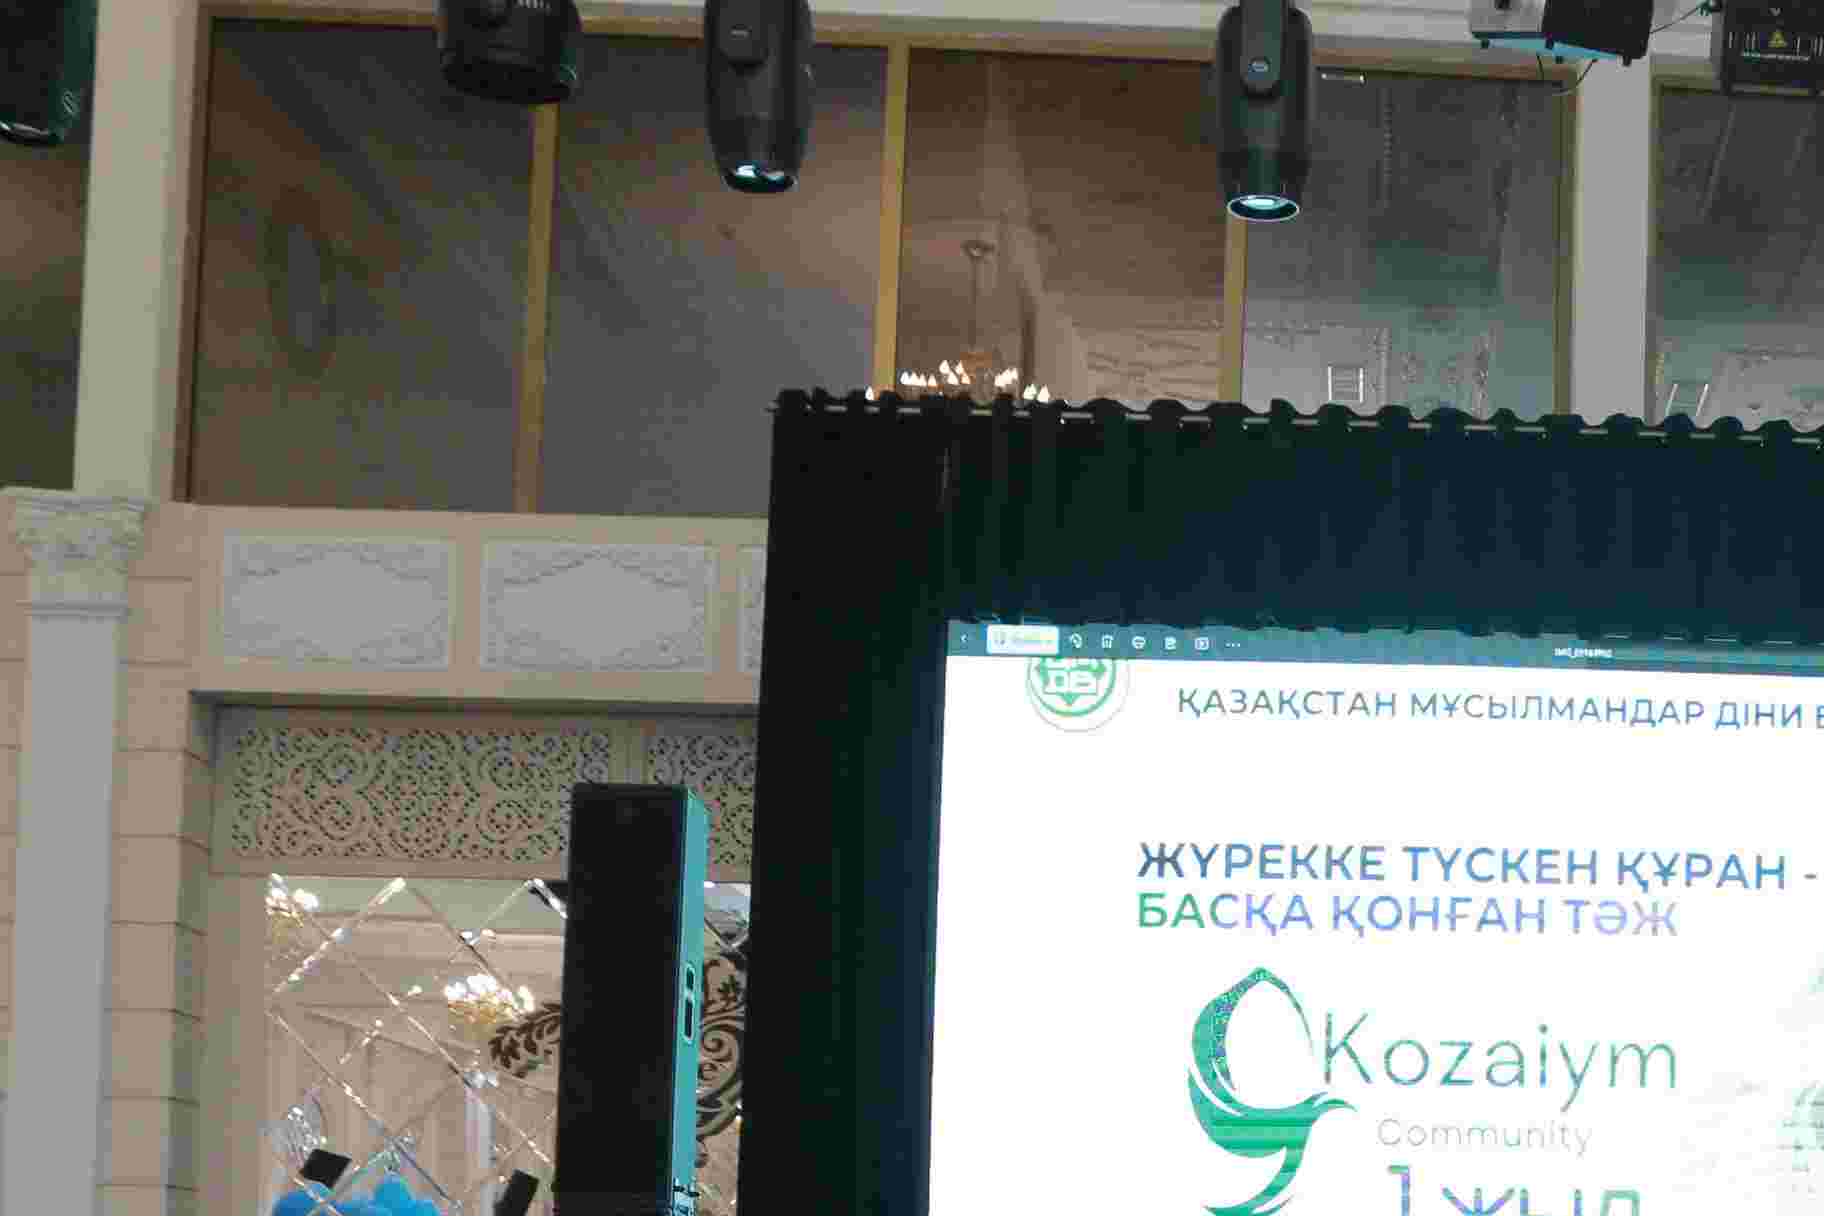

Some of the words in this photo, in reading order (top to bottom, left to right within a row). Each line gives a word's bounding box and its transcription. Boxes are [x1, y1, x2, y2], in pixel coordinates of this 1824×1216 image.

[1177, 687, 1397, 718] ҚАЗАҚСТАН
[1411, 694, 1706, 726] МҰСЫЛМАНДАР
[1714, 701, 1803, 730] ДІНИ
[1137, 842, 1385, 881] ЖҮРЕККЕ
[1402, 846, 1598, 886] ТҮСКЕН
[1616, 851, 1786, 893] ҚҰРАН
[1136, 892, 1314, 936] БАСҚА
[1331, 894, 1547, 940] ҚОНҒАН
[1563, 900, 1679, 935] ТӘЖ
[1323, 1012, 1678, 1111] Kozaiym
[1376, 1117, 1592, 1156] Community
